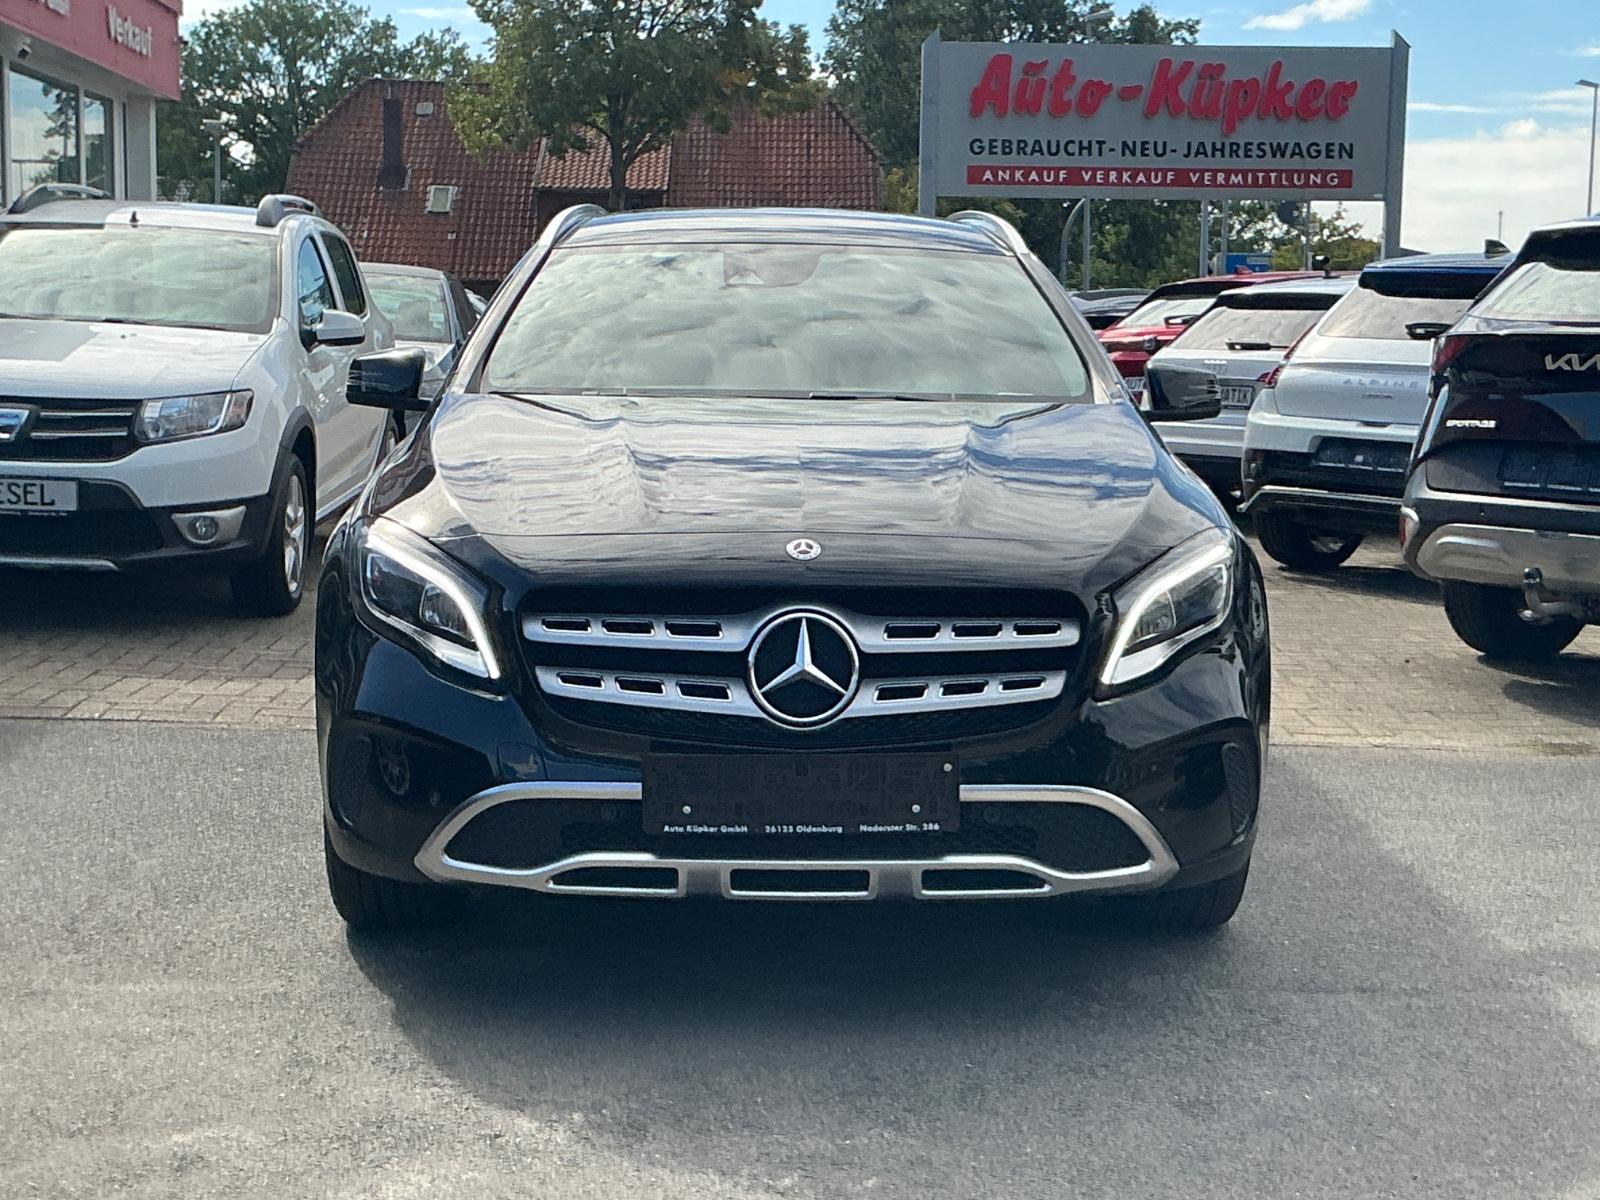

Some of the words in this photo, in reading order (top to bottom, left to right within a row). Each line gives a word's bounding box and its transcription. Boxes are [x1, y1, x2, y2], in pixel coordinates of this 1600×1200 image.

[107, 4, 153, 57] Verkauf
[982, 169, 1069, 183] ANKAUF
[1081, 170, 1176, 184] VERKAUF
[1189, 171, 1340, 186] VERMITTLUNG
[720, 824, 748, 833] GmbH
[765, 825, 794, 833] 26125
[796, 824, 842, 834] Oldenburg
[905, 822, 920, 831] Str.
